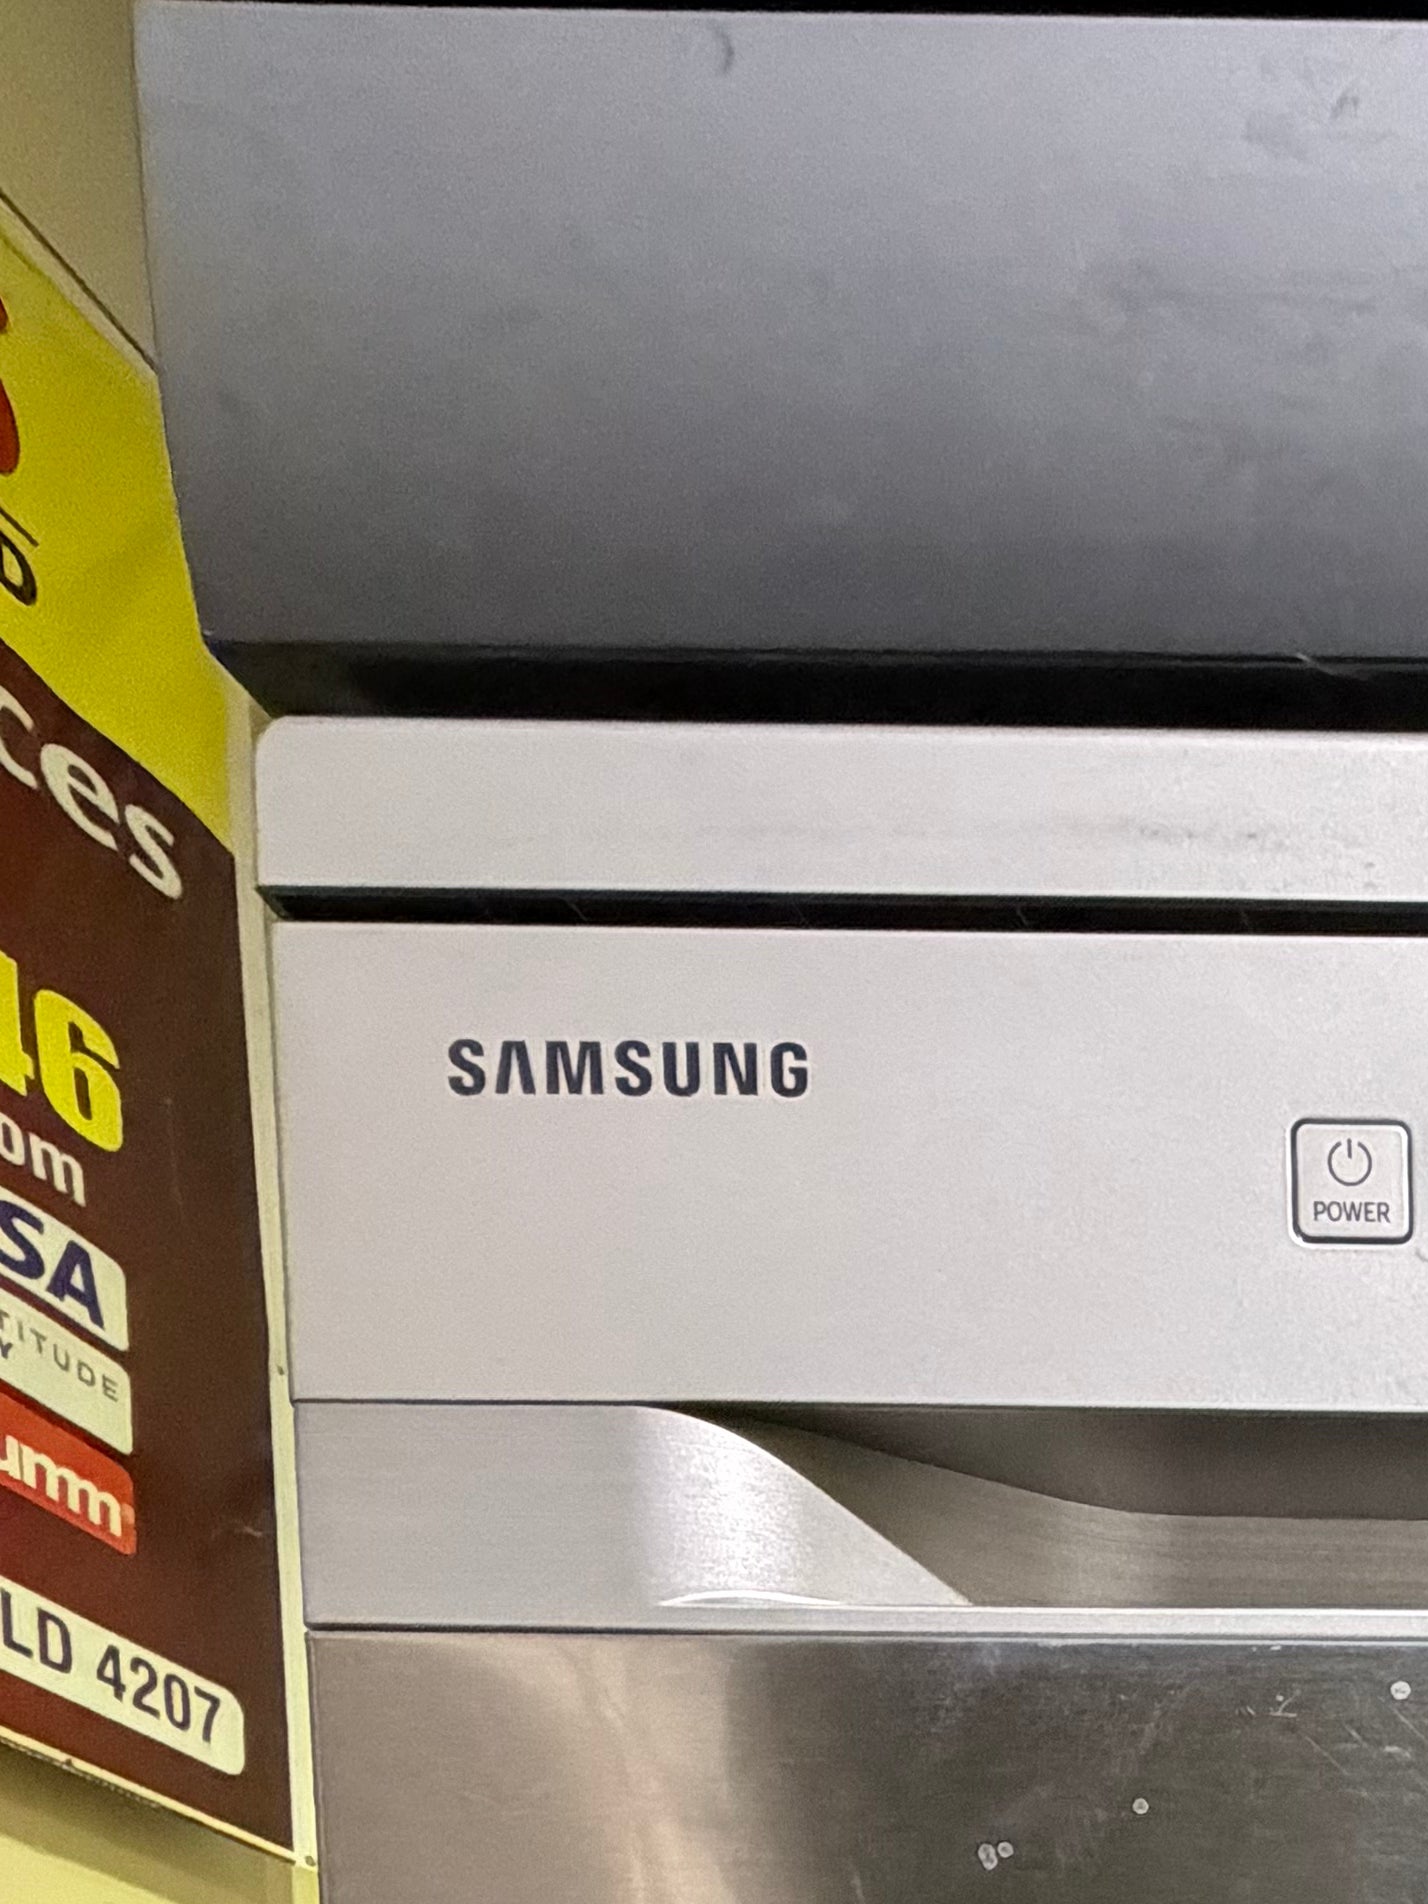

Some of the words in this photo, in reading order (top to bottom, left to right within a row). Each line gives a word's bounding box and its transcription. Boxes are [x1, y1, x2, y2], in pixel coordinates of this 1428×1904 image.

[448, 1038, 808, 1097] SAMSUNG
[1313, 1200, 1390, 1223] POWER
[96, 1643, 221, 1744] 4207
